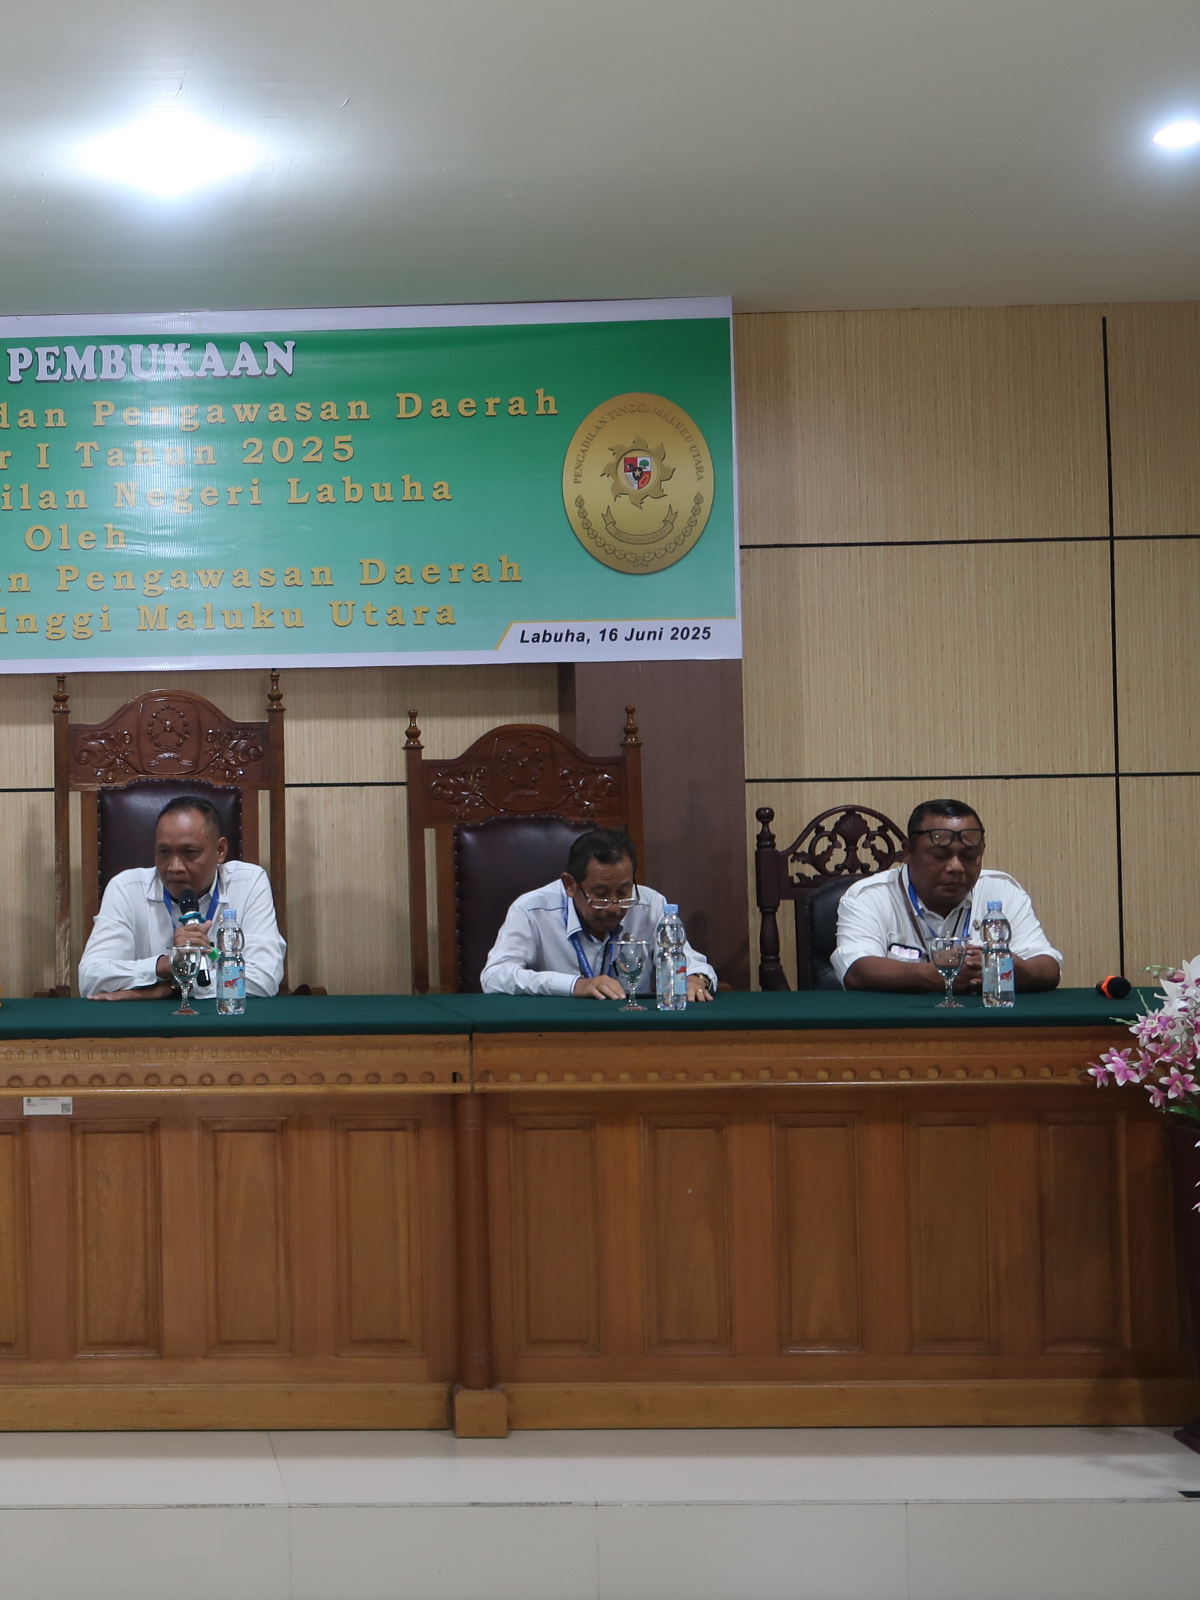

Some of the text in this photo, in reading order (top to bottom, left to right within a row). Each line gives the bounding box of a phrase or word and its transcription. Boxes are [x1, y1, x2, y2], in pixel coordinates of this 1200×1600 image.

[6, 339, 296, 384] PEMBUKAAN
[92, 400, 371, 433] Pengawasan
[395, 387, 559, 420] Daerah
[36, 442, 50, 470] I
[74, 439, 217, 469] Tahun
[242, 434, 355, 465] 2025
[573, 418, 608, 484] PENGADILAN
[689, 445, 705, 482] UTARA
[113, 477, 262, 515] Negeri
[286, 473, 453, 505] Labuha
[24, 522, 128, 552] Oleh
[56, 564, 335, 599] Pengawasan
[359, 554, 523, 586] Daerah
[136, 600, 306, 632] Maluku
[328, 599, 457, 628] Utara
[520, 625, 712, 645] Labuha, 16 Juni 2025
